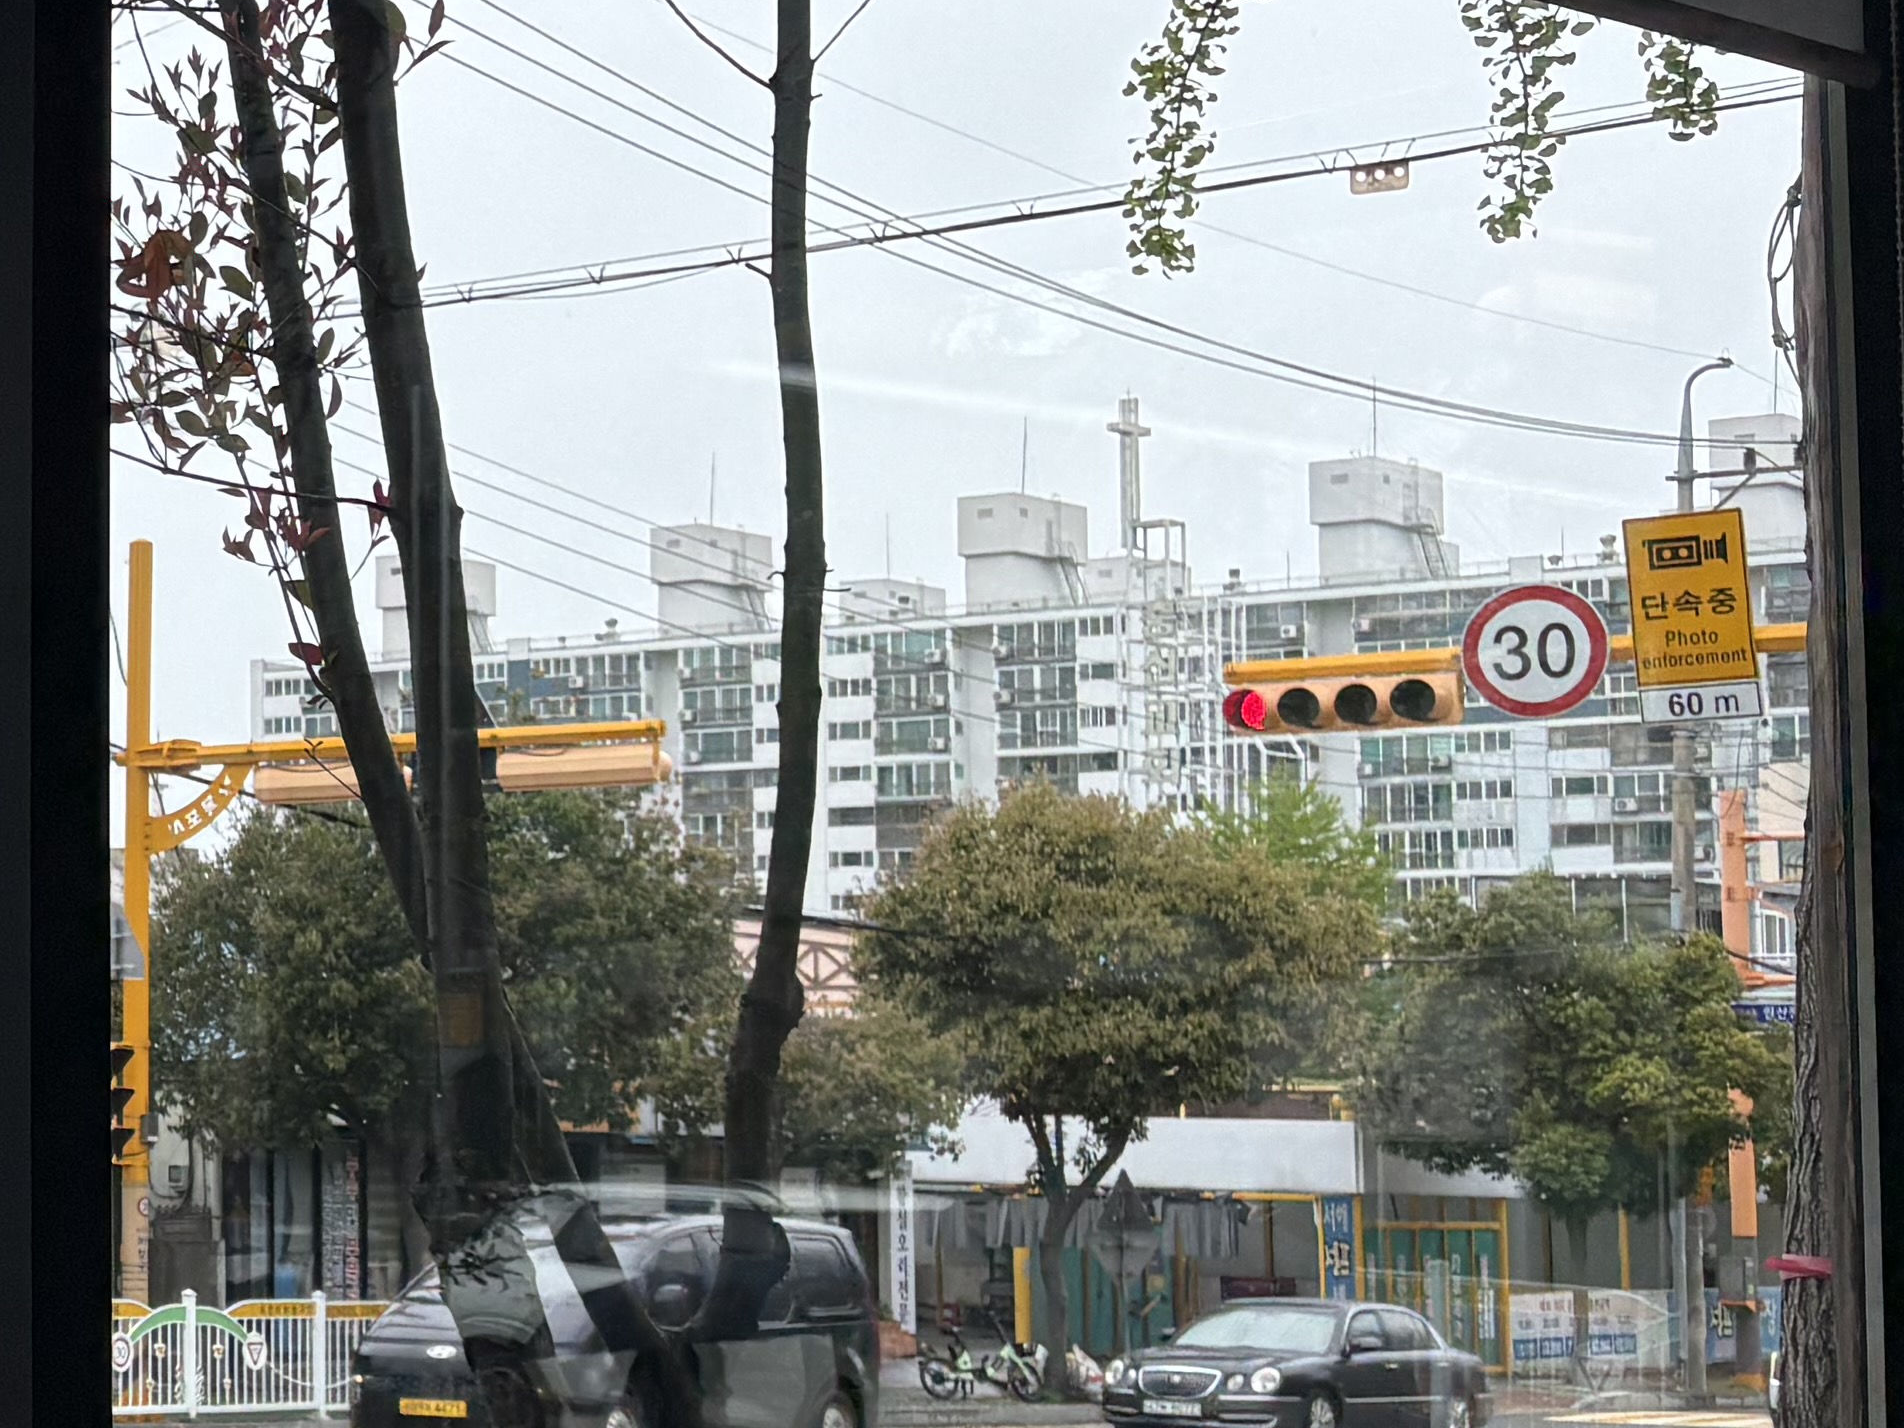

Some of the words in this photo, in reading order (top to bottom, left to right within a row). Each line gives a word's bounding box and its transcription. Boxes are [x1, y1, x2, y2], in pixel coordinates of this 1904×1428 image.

[1641, 587, 1737, 621] 단속중
[1493, 622, 1576, 681] 30
[1665, 629, 1719, 648] Photo
[1642, 648, 1748, 670] enforcement
[1668, 691, 1703, 717] 60
[1714, 693, 1739, 714] m
